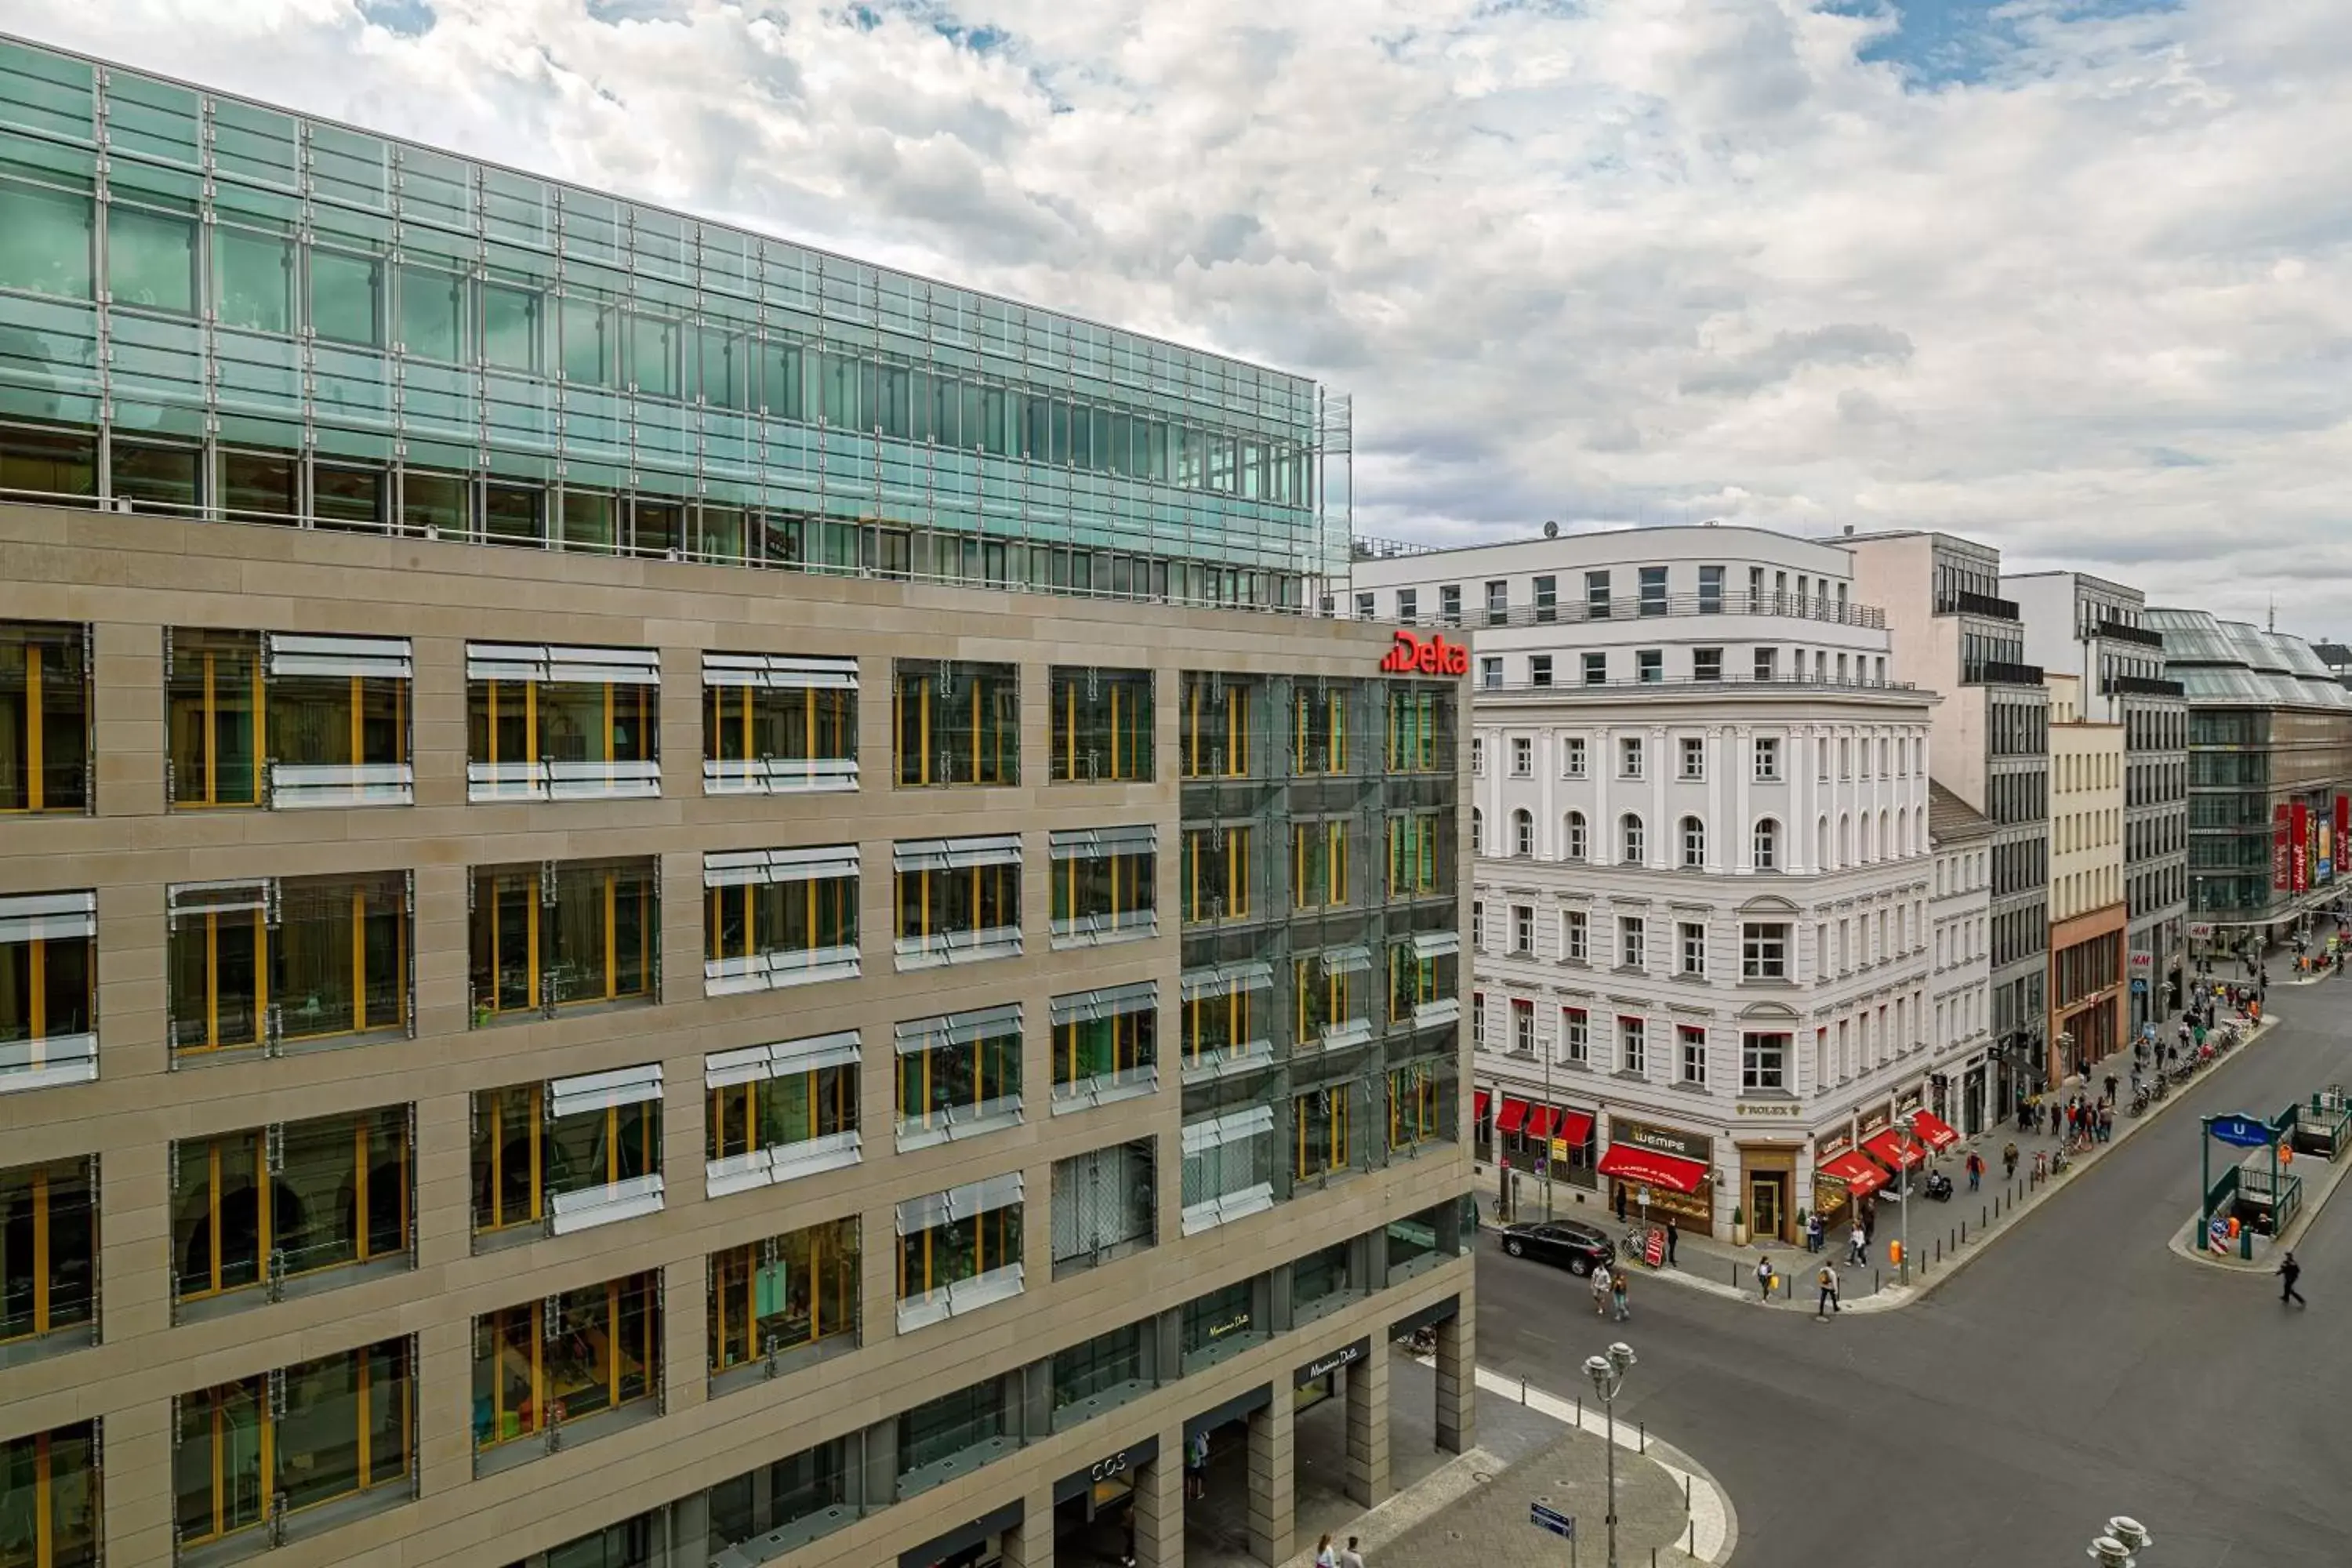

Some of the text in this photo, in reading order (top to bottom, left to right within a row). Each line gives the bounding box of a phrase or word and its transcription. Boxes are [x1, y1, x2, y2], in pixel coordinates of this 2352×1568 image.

[1392, 630, 1468, 674] Deka
[1748, 1106, 1788, 1115] ROLEX
[2233, 1122, 2245, 1134] U
[1092, 1452, 1127, 1482] COS
